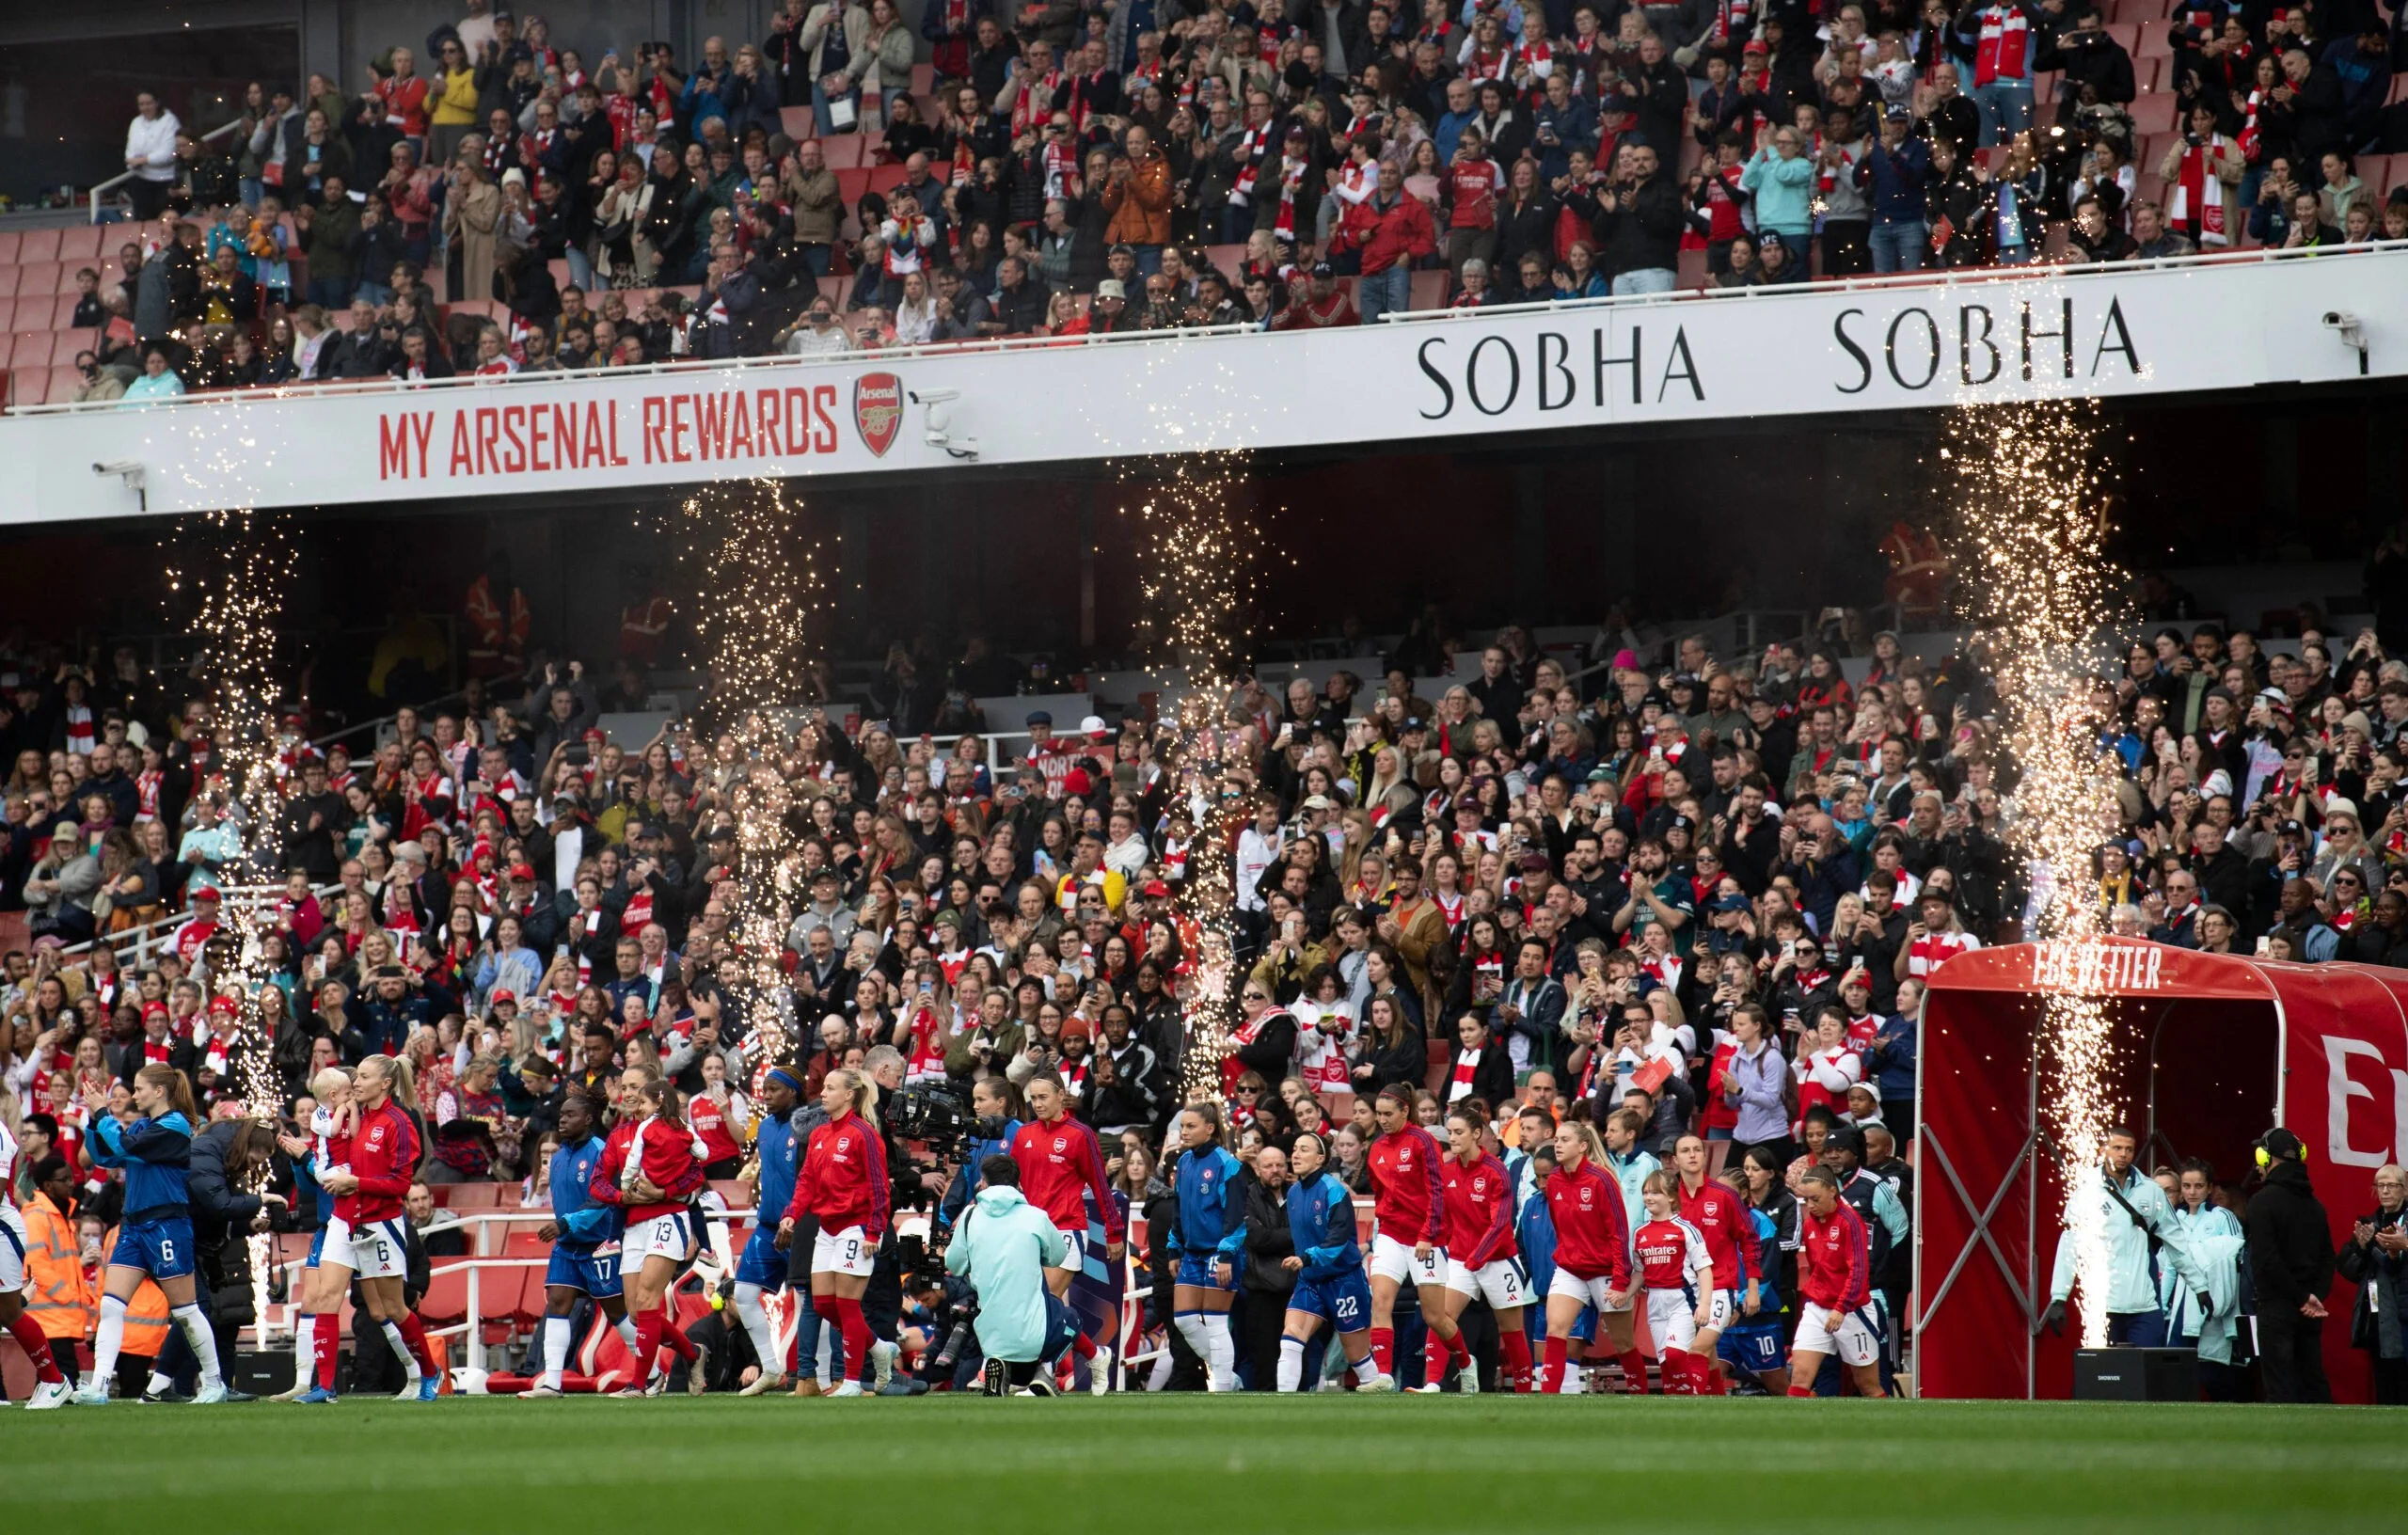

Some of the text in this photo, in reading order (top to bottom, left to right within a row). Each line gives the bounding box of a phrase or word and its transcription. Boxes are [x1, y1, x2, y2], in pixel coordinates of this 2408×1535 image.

[1834, 293, 2143, 393] SOBHA
[1418, 323, 1705, 419] SOBHA
[860, 386, 896, 399] Arsenal
[380, 385, 837, 480] MY ARSENAL REWARDS
[1038, 752, 1087, 777] NORT
[2076, 942, 2162, 989] BETTER
[1846, 1037, 1867, 1052] VC
[656, 1222, 672, 1242] 13
[161, 1240, 174, 1261] 6
[376, 1241, 389, 1261] 6
[846, 1239, 858, 1260] 9
[1638, 1245, 1677, 1257] Emirates
[594, 1258, 611, 1280] 17
[1504, 1273, 1516, 1292] 2
[1336, 1296, 1358, 1318] 22
[1714, 1300, 1724, 1319] 3
[1755, 1336, 1776, 1355] 10
[1854, 1333, 1867, 1353] 11
